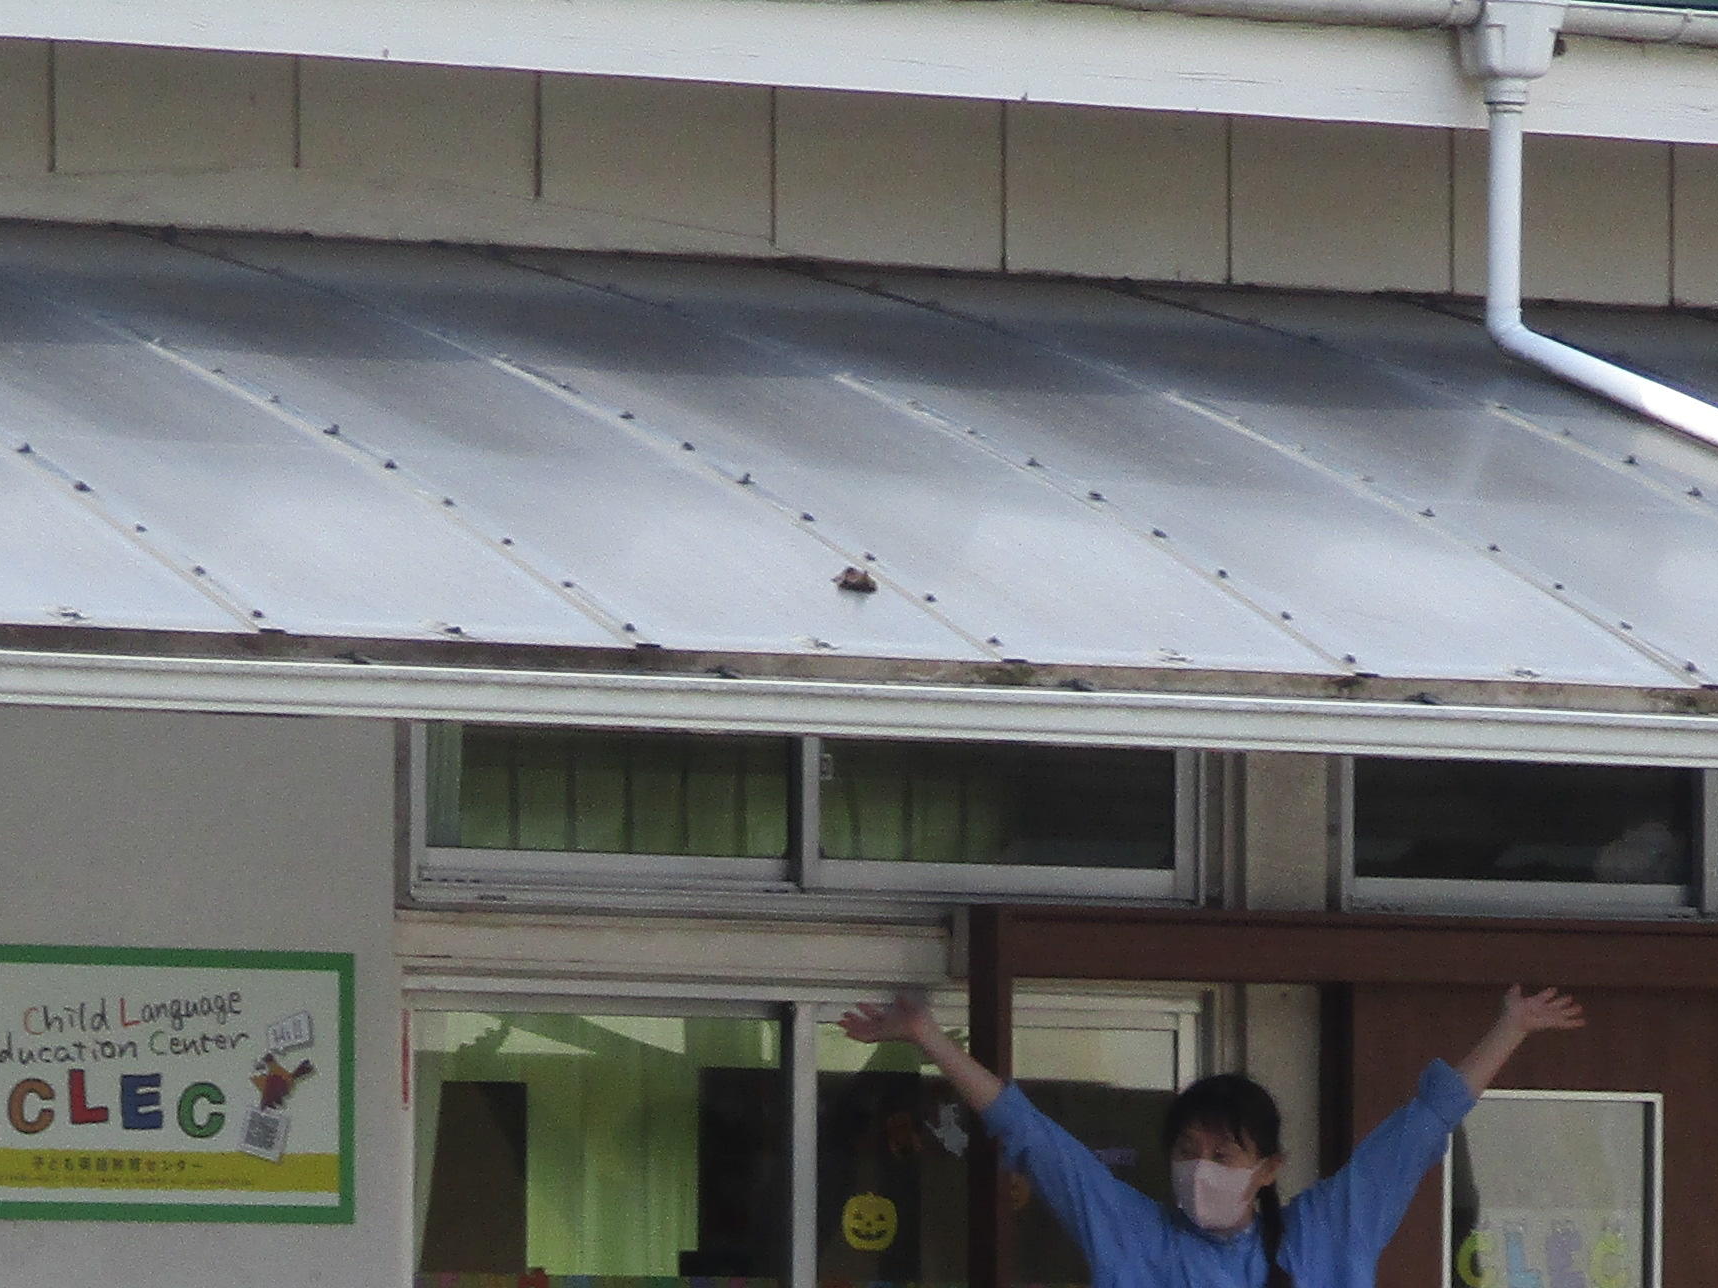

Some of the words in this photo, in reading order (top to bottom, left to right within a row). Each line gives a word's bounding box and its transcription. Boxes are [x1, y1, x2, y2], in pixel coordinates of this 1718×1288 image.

[24, 997, 110, 1035] Child
[119, 990, 243, 1031] Language
[149, 1030, 250, 1056] Center
[7, 1068, 226, 1139] CLEC
